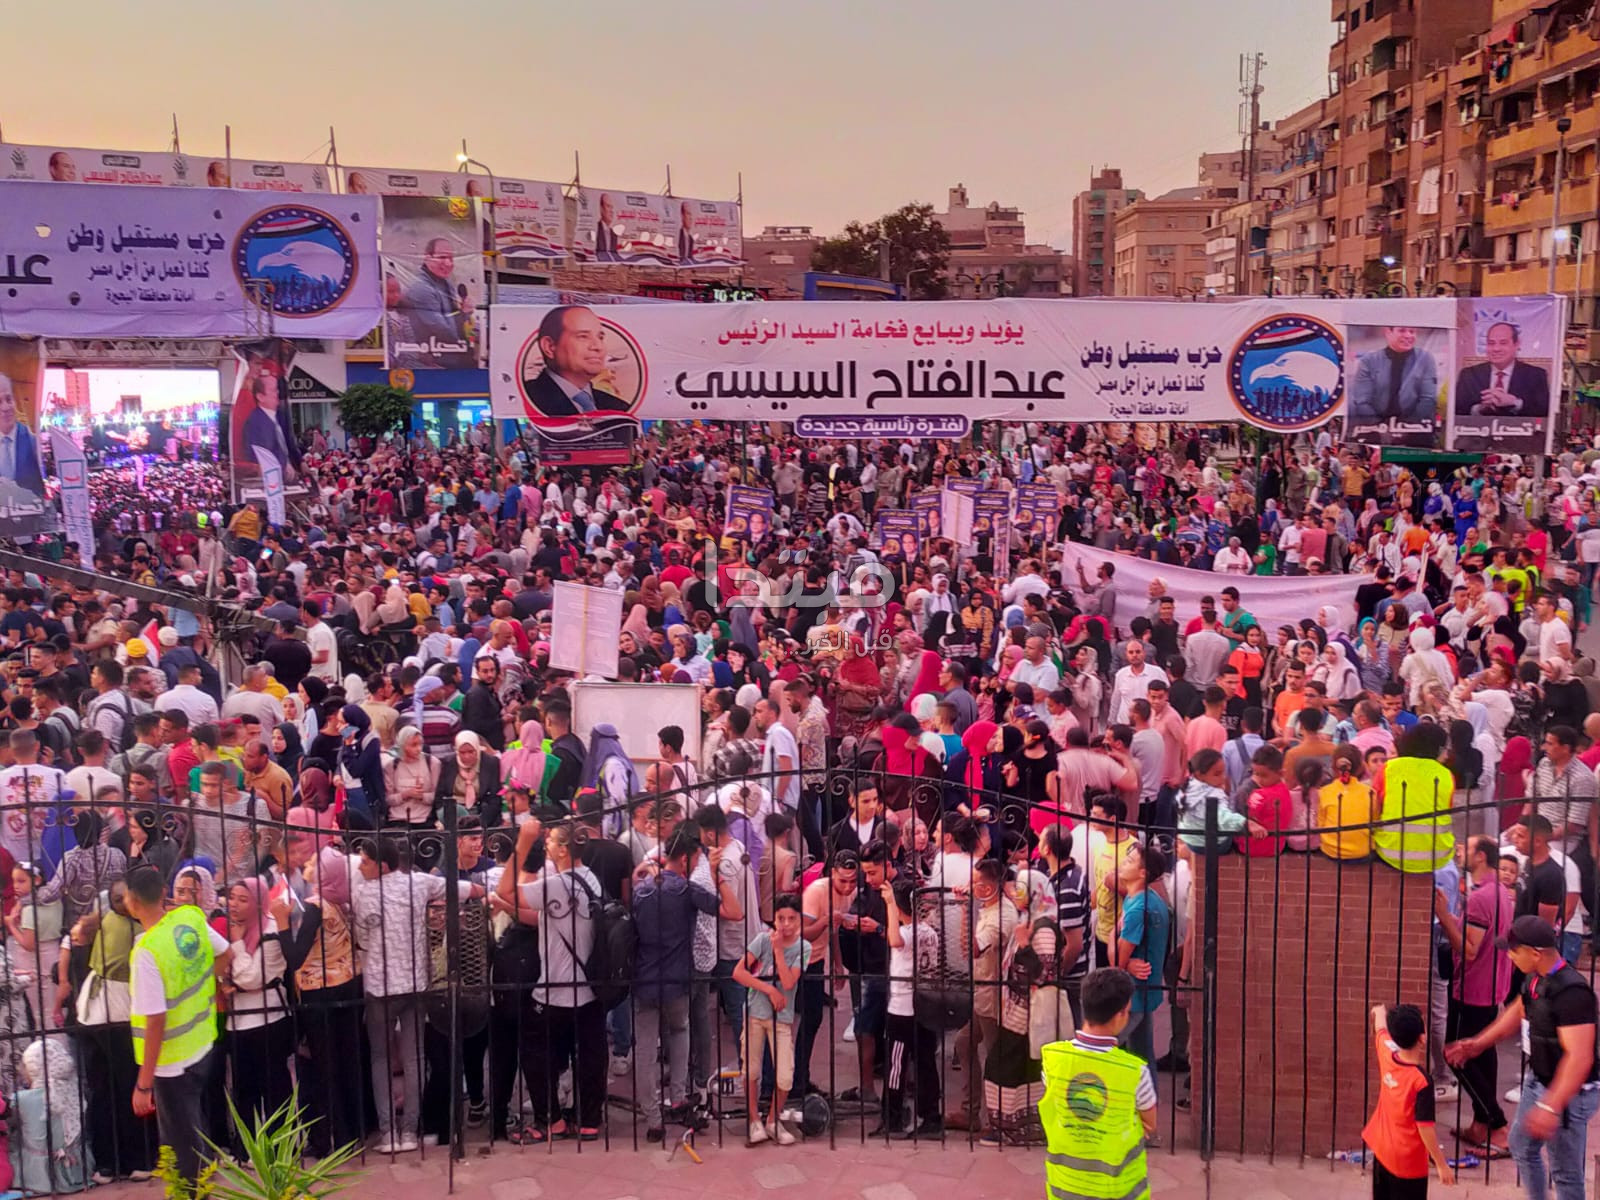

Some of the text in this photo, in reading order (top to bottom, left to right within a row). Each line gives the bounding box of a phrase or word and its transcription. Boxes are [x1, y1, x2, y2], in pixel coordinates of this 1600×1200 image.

[67, 222, 225, 255] حزب مستقبل وطن
[86, 256, 209, 282] كلنا نعمل من أجل مصر
[718, 318, 1024, 346] يؤيد ويبايع فخامة السيد الرئيس
[394, 335, 468, 358] تحيا مصر
[1081, 340, 1223, 369] حزب مستقبل وطن
[675, 360, 857, 410] السيسي
[1095, 372, 1206, 396] كلنا نعمل من أجل مصر
[801, 416, 964, 435] لفترة رئاسية جديدة
[1353, 416, 1433, 437] تحيا مصر
[1454, 418, 1533, 440] تحيا مص
